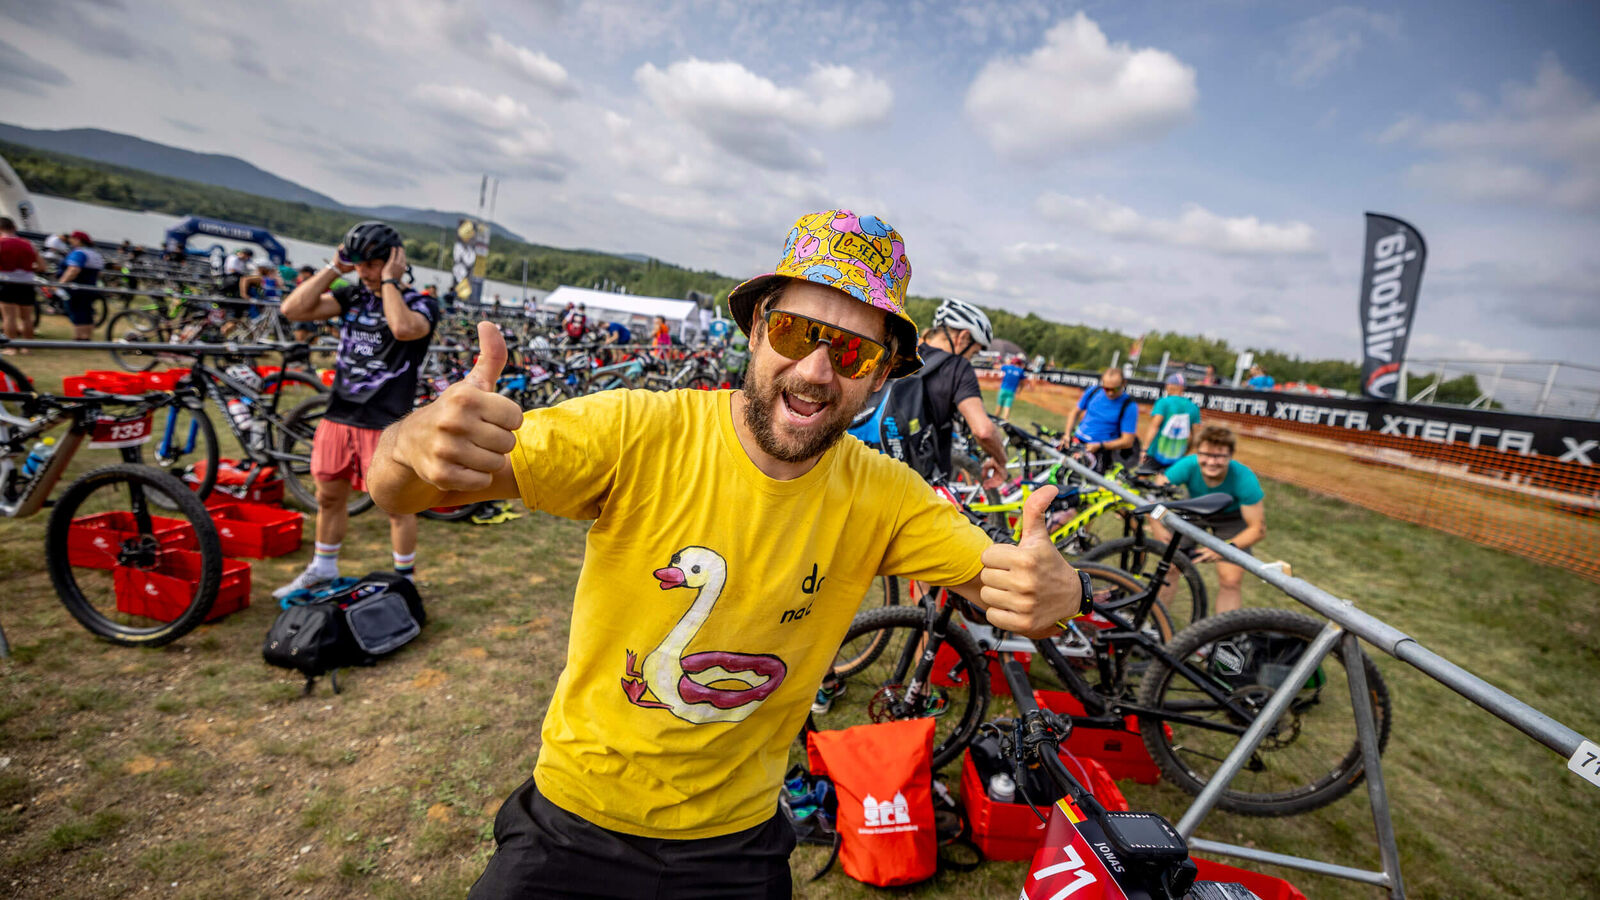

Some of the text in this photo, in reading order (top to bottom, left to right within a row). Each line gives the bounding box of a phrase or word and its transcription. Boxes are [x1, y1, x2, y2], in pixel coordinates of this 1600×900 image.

[843, 238, 877, 262] O-SEE
[111, 421, 145, 440] 133
[1207, 394, 1269, 416] XTERRA
[1273, 401, 1369, 431] XTERRA
[1380, 414, 1535, 456] XTERRA
[1033, 844, 1097, 900] 71
[1093, 842, 1125, 873] JONAS
